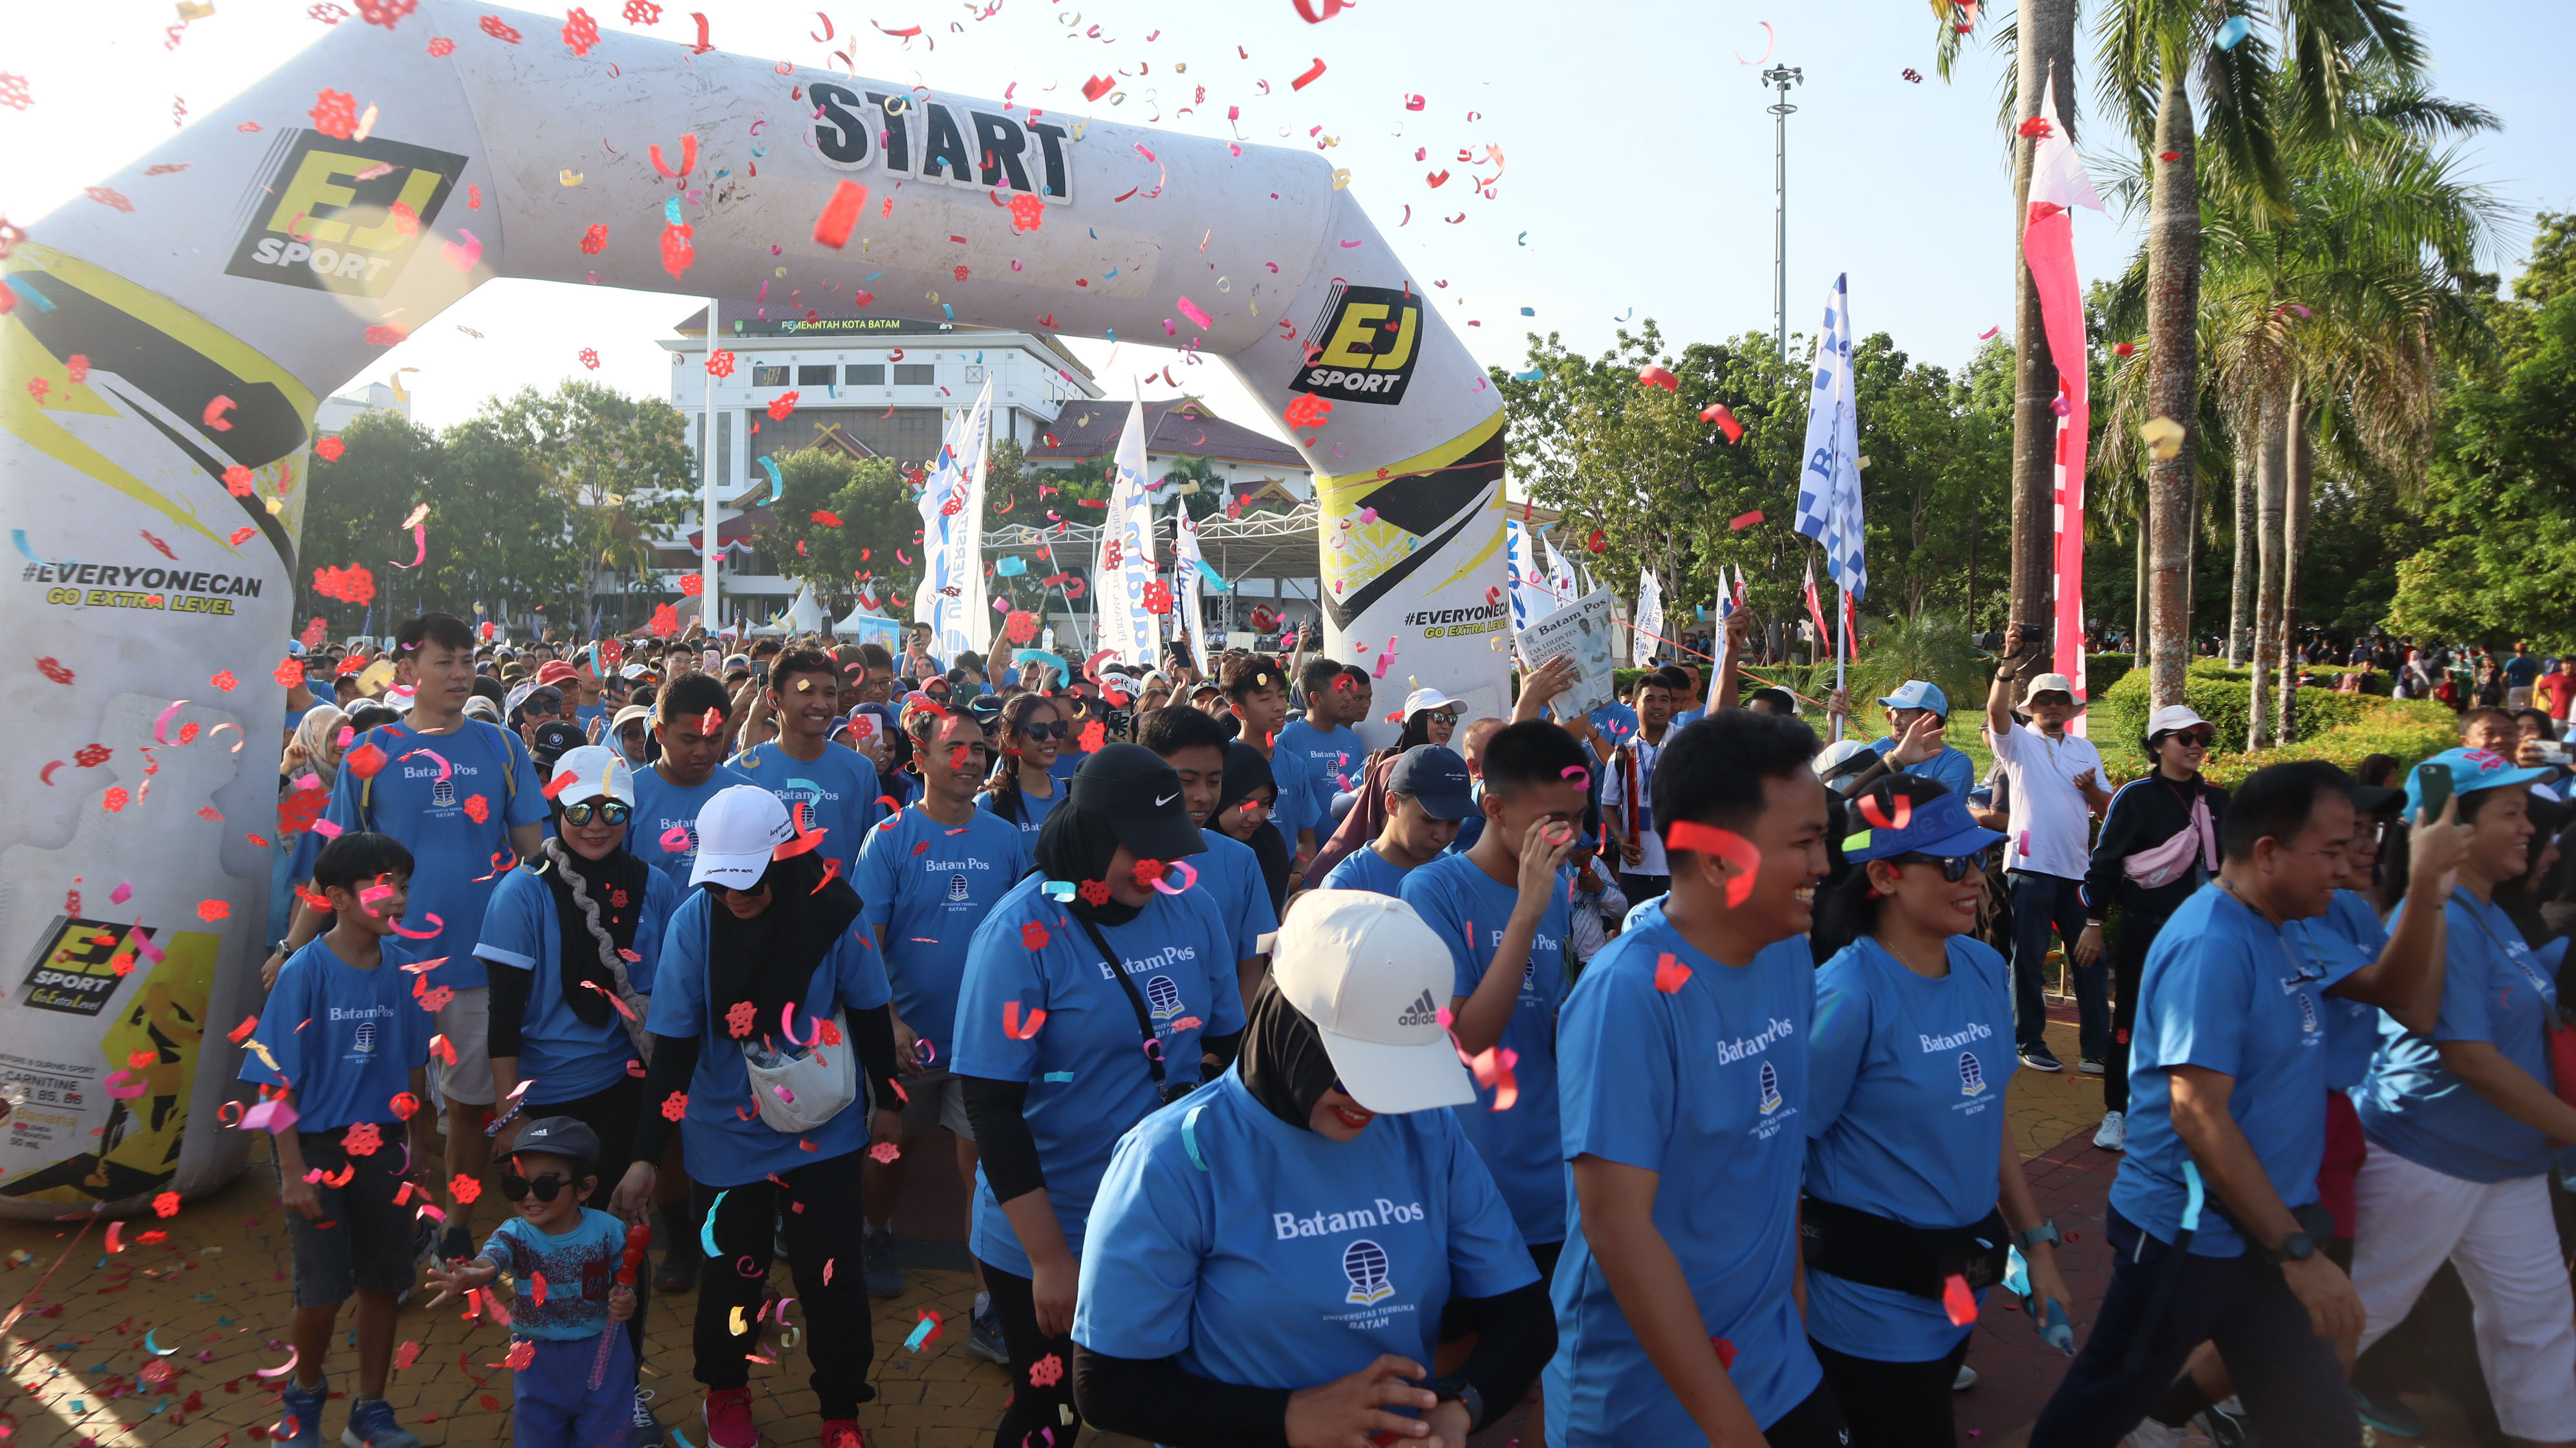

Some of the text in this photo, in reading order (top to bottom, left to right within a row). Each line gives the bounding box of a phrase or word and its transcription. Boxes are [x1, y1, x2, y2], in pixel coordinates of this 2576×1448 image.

[809, 83, 1067, 198] START
[266, 150, 444, 252] EJ
[251, 238, 392, 283] SPORT
[782, 321, 839, 329] PEMERINTAH
[1318, 303, 1417, 370] EJ
[1306, 368, 1401, 393] SPORT
[21, 562, 262, 597] #EVERYONECAN
[47, 588, 235, 615] GO EXTRA LEVEL
[1404, 601, 1510, 626] #EVERYONECA
[1424, 618, 1507, 639] GO EXTRA LEVEL
[1538, 599, 1606, 636] Batam Pos
[1529, 628, 1578, 657] TAK LOLOS TES
[404, 763, 478, 778] Bata Pos
[774, 789, 815, 800] Batam
[926, 858, 989, 871] Batam Pos
[42, 925, 139, 976] EJ
[1537, 934, 1557, 950] Pos
[1098, 946, 1195, 980] Btam Pos
[33, 970, 113, 992] SPORT
[330, 1005, 394, 1020] Batam Pos
[1399, 1012, 1437, 1026] adida
[1155, 1027, 1179, 1038] BATA
[1768, 1018, 1793, 1043] Pos
[1919, 1023, 1992, 1053] Batam Pos
[1272, 1198, 1424, 1240] Batam Pos
[1322, 1303, 1415, 1321] UNIVERSITAS TERBUKA
[1349, 1317, 1389, 1330] BATAM
